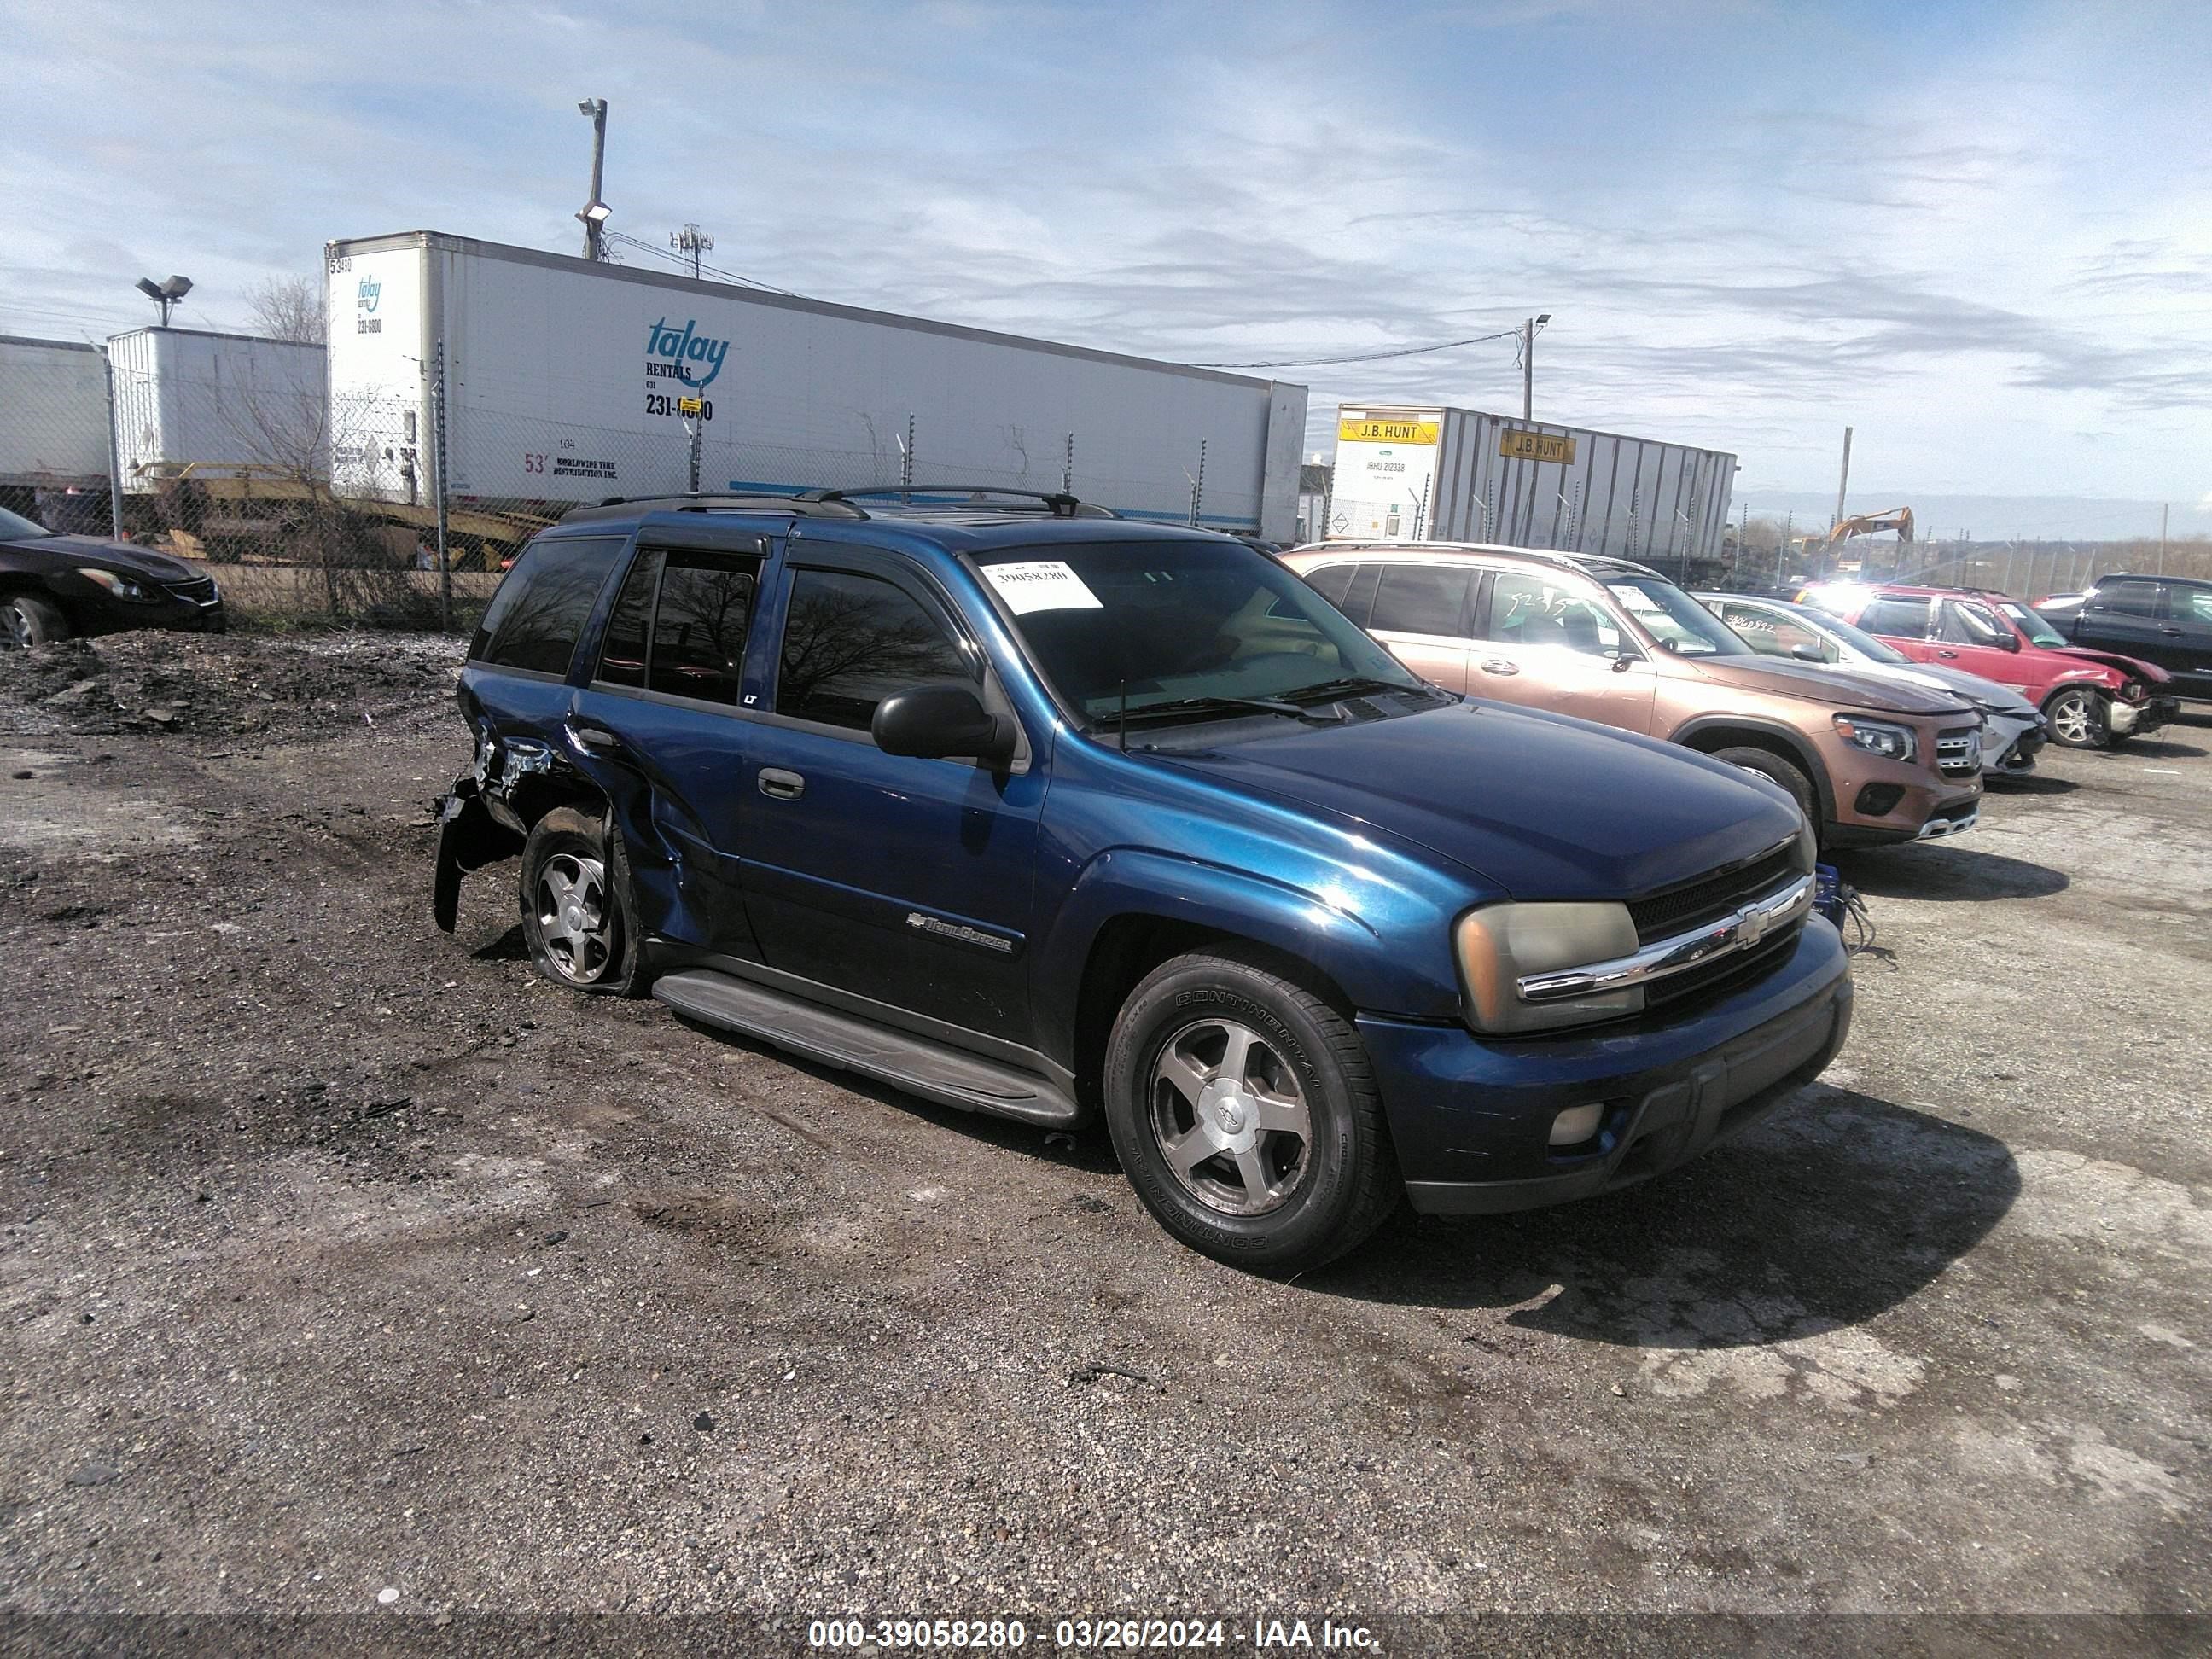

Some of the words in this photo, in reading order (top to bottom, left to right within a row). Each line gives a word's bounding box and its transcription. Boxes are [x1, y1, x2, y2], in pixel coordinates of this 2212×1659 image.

[646, 316, 731, 387] talay
[646, 362, 691, 380] RENTALS
[1360, 424, 1382, 438] J.B.
[1384, 425, 1418, 439] HUNT
[1516, 436, 1534, 453] J.B.
[1536, 438, 1563, 457] HUNT
[743, 694, 758, 705] LT
